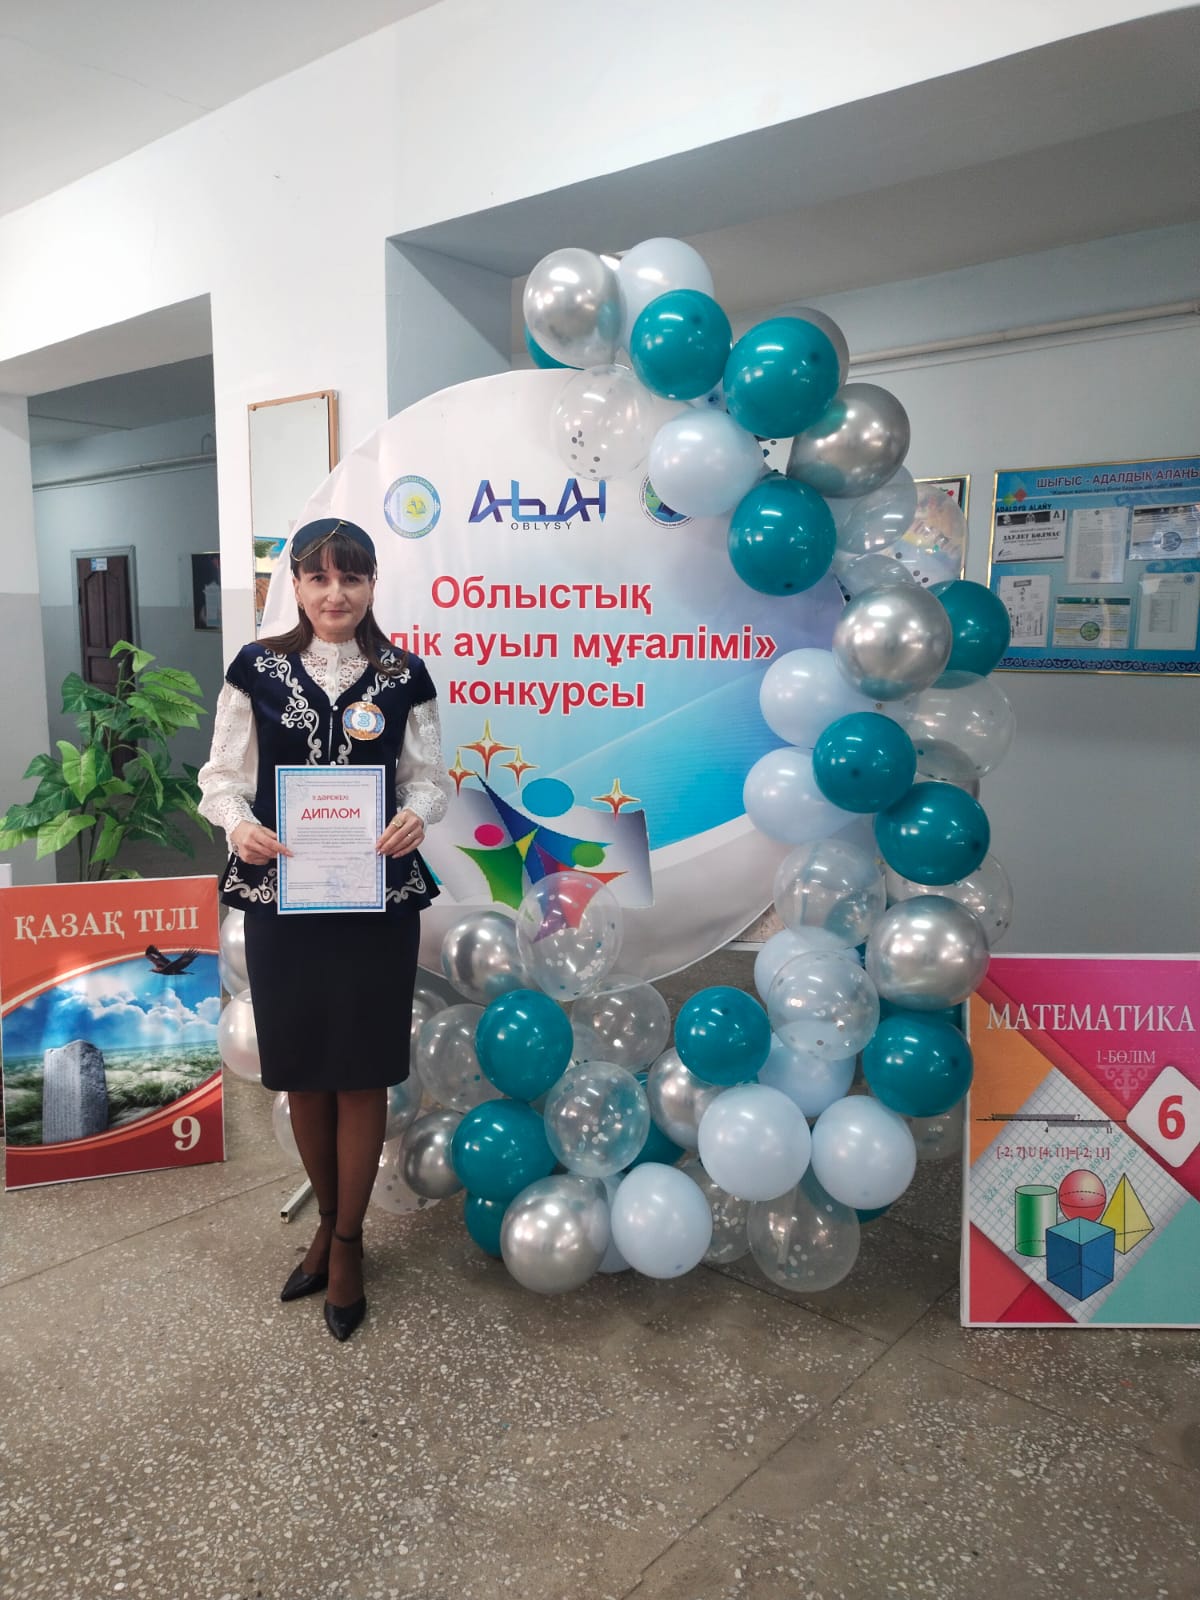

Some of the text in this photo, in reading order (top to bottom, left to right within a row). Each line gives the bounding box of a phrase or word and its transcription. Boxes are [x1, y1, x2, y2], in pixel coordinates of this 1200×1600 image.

[510, 522, 572, 531] OBLYSY
[431, 576, 652, 616] Облыстық
[454, 632, 558, 666] ауыл
[573, 625, 777, 667] мұғалімі»
[449, 680, 645, 714] конкурсы
[358, 712, 370, 727] 3
[301, 808, 361, 820] ДИПЛОМ
[14, 907, 200, 944] ҚАЗАҚ ТІЛІ
[986, 1003, 1196, 1032] МАТЕМАТИКА
[172, 1116, 201, 1151] 9
[1158, 1095, 1186, 1139] 6
